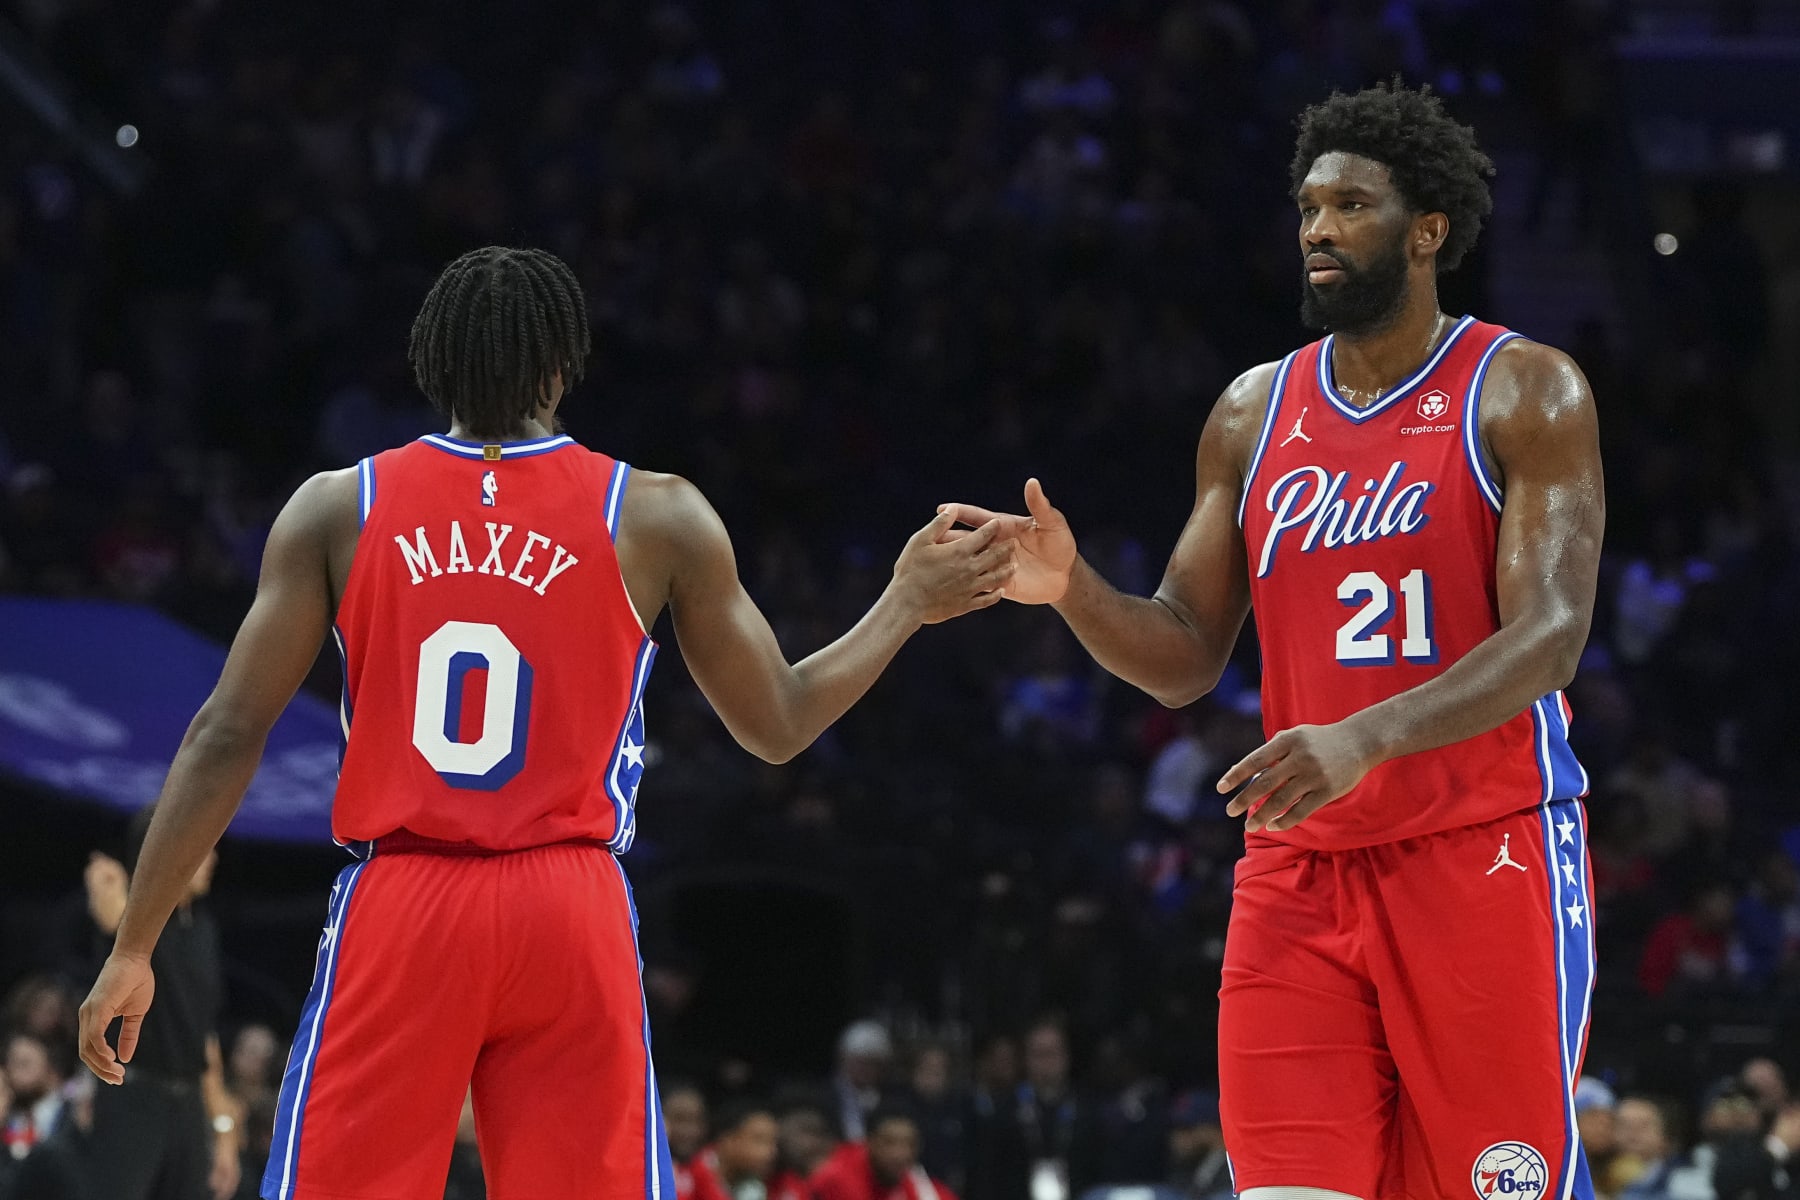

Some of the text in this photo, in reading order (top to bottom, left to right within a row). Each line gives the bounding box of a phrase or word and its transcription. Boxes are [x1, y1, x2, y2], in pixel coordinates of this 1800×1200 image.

[1400, 423, 1455, 436] crypto.com
[394, 521, 579, 596] MAXEY
[1257, 461, 1435, 578] Phila
[1336, 569, 1438, 665] 21
[412, 620, 533, 791] 0
[1481, 1168, 1541, 1194] 76ers
